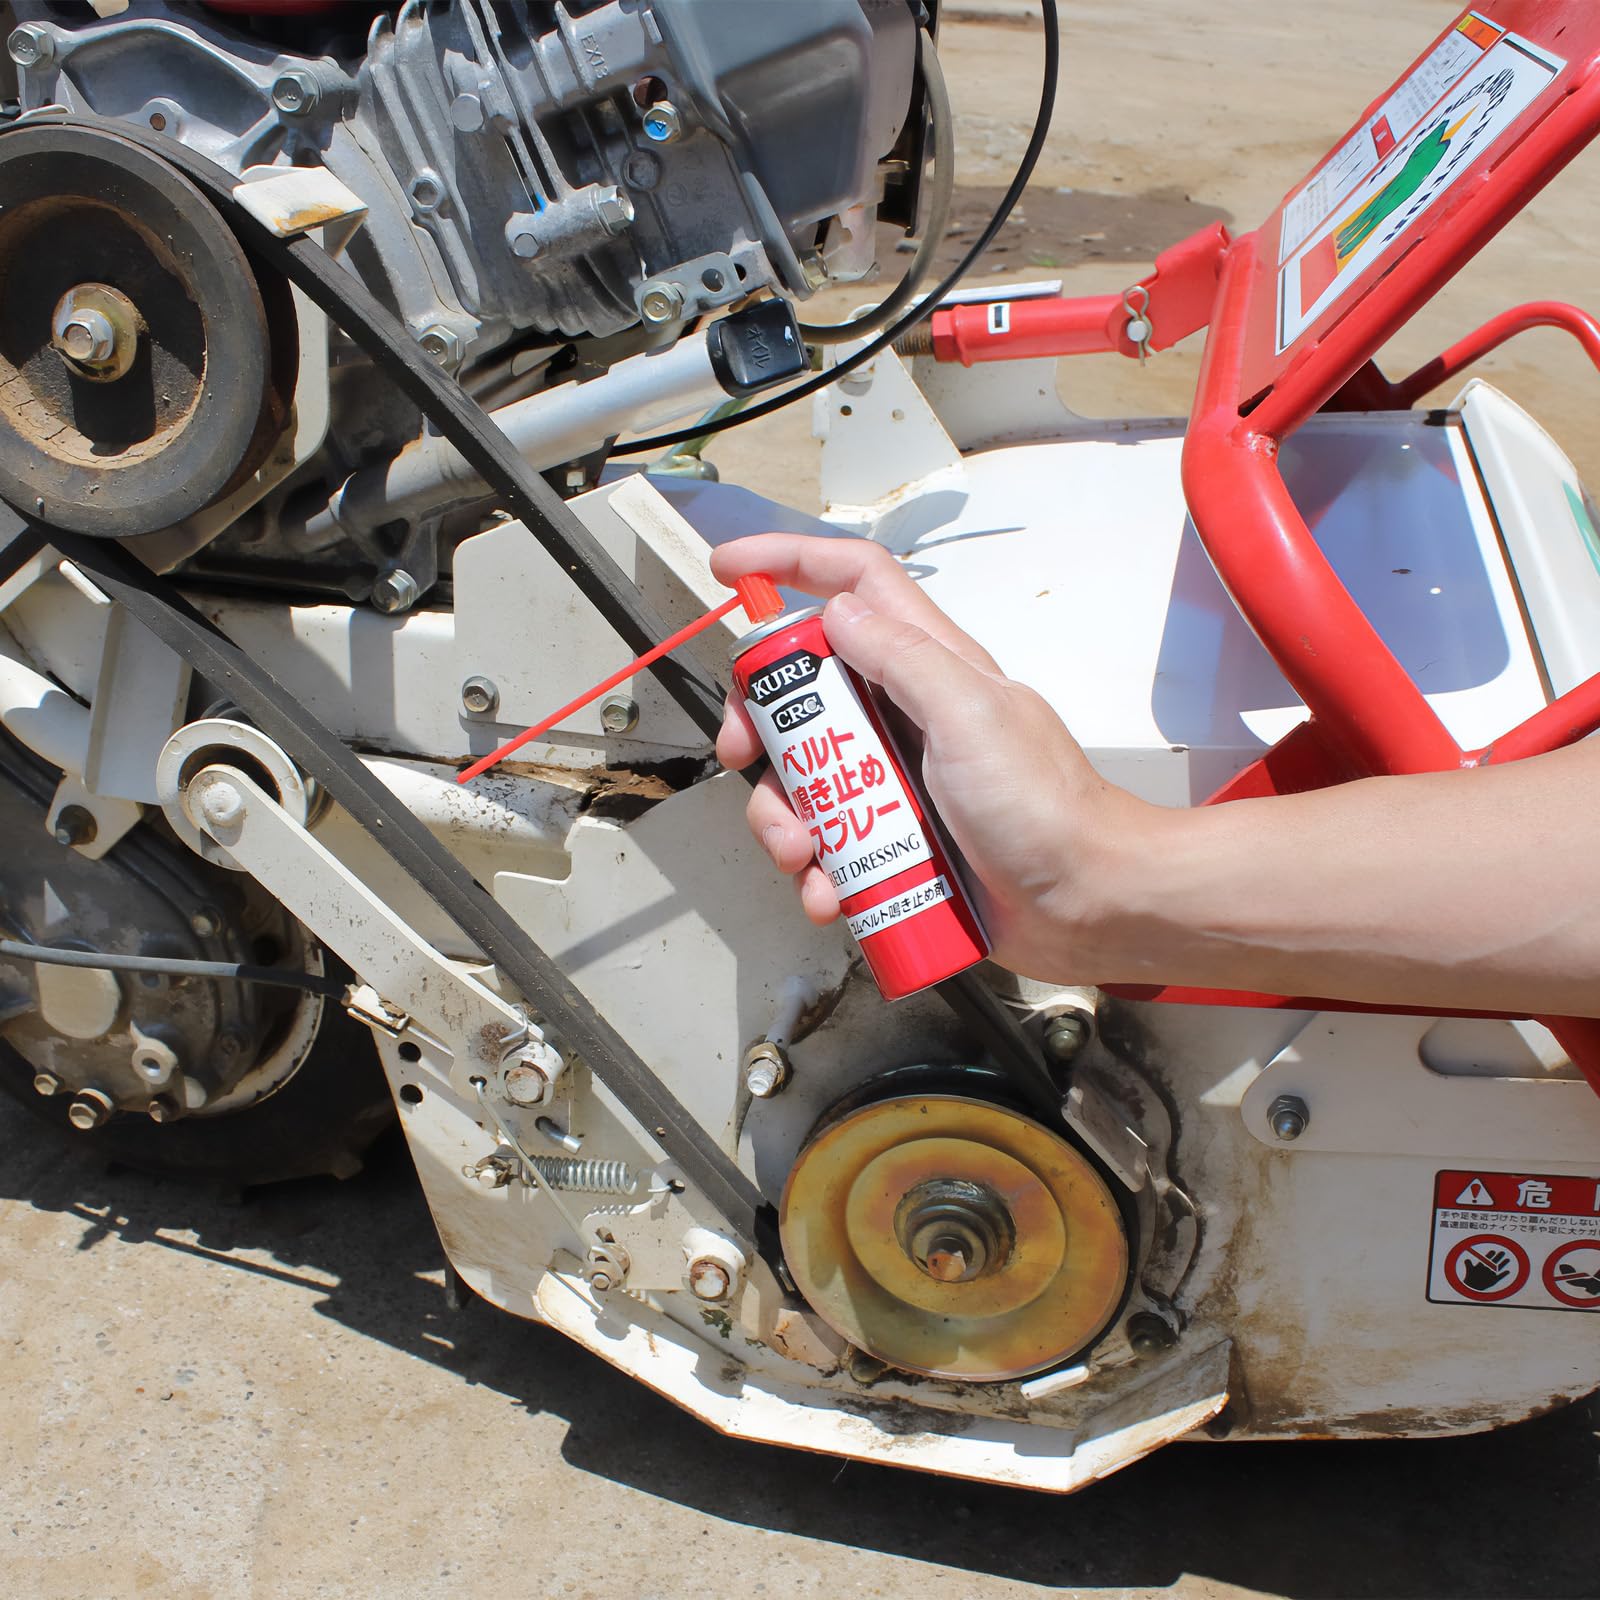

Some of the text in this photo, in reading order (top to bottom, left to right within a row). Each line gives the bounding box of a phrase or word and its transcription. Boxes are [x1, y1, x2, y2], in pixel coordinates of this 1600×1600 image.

[746, 325, 771, 369] オイル
[751, 655, 816, 701] KURE
[776, 696, 821, 728] CRC
[781, 727, 855, 777] ベルト
[792, 754, 886, 823] 鳴き止め
[809, 800, 901, 860] スプレー
[828, 832, 920, 889] BELT DRESSING
[1440, 1211, 1600, 1227] 手や足を近づけたり踏んだりしない
[1440, 1219, 1600, 1237] 高速回転のナイフで手や足に大ケガ
